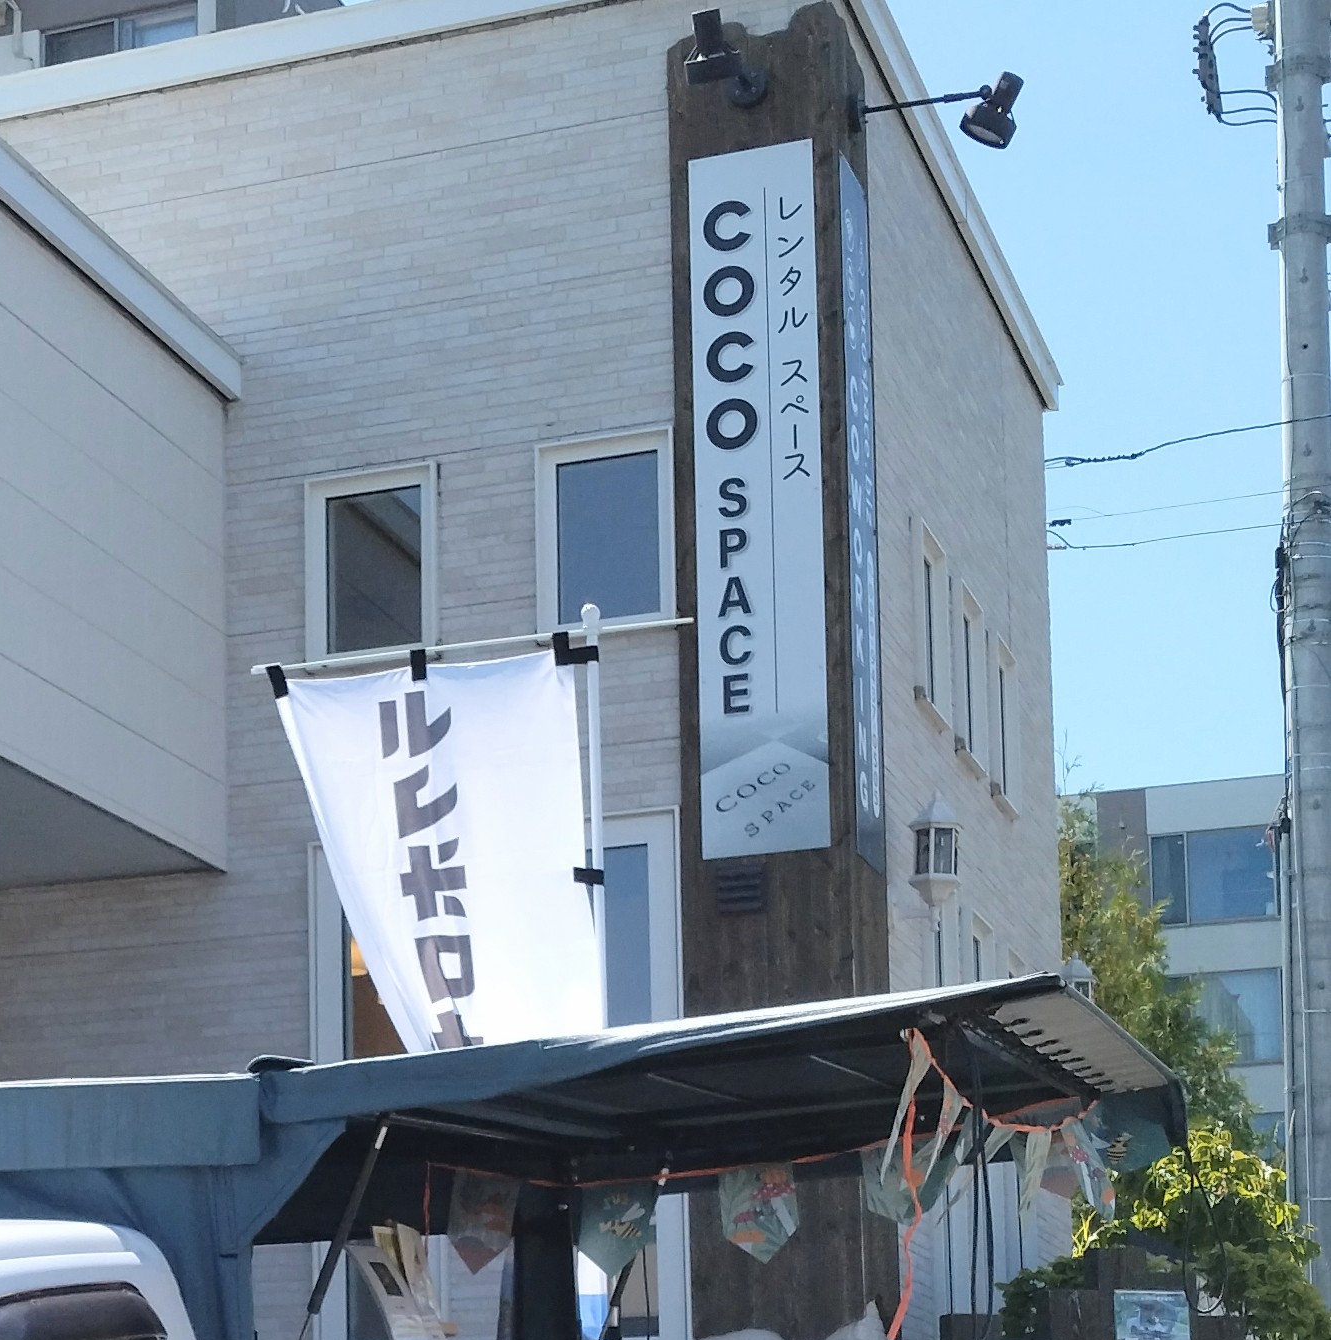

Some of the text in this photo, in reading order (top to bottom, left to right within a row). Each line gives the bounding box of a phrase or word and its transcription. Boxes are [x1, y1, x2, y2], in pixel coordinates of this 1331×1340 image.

[703, 200, 758, 714] COCO SPACE
[715, 762, 791, 814] COCO
[744, 779, 816, 838] SPACE
